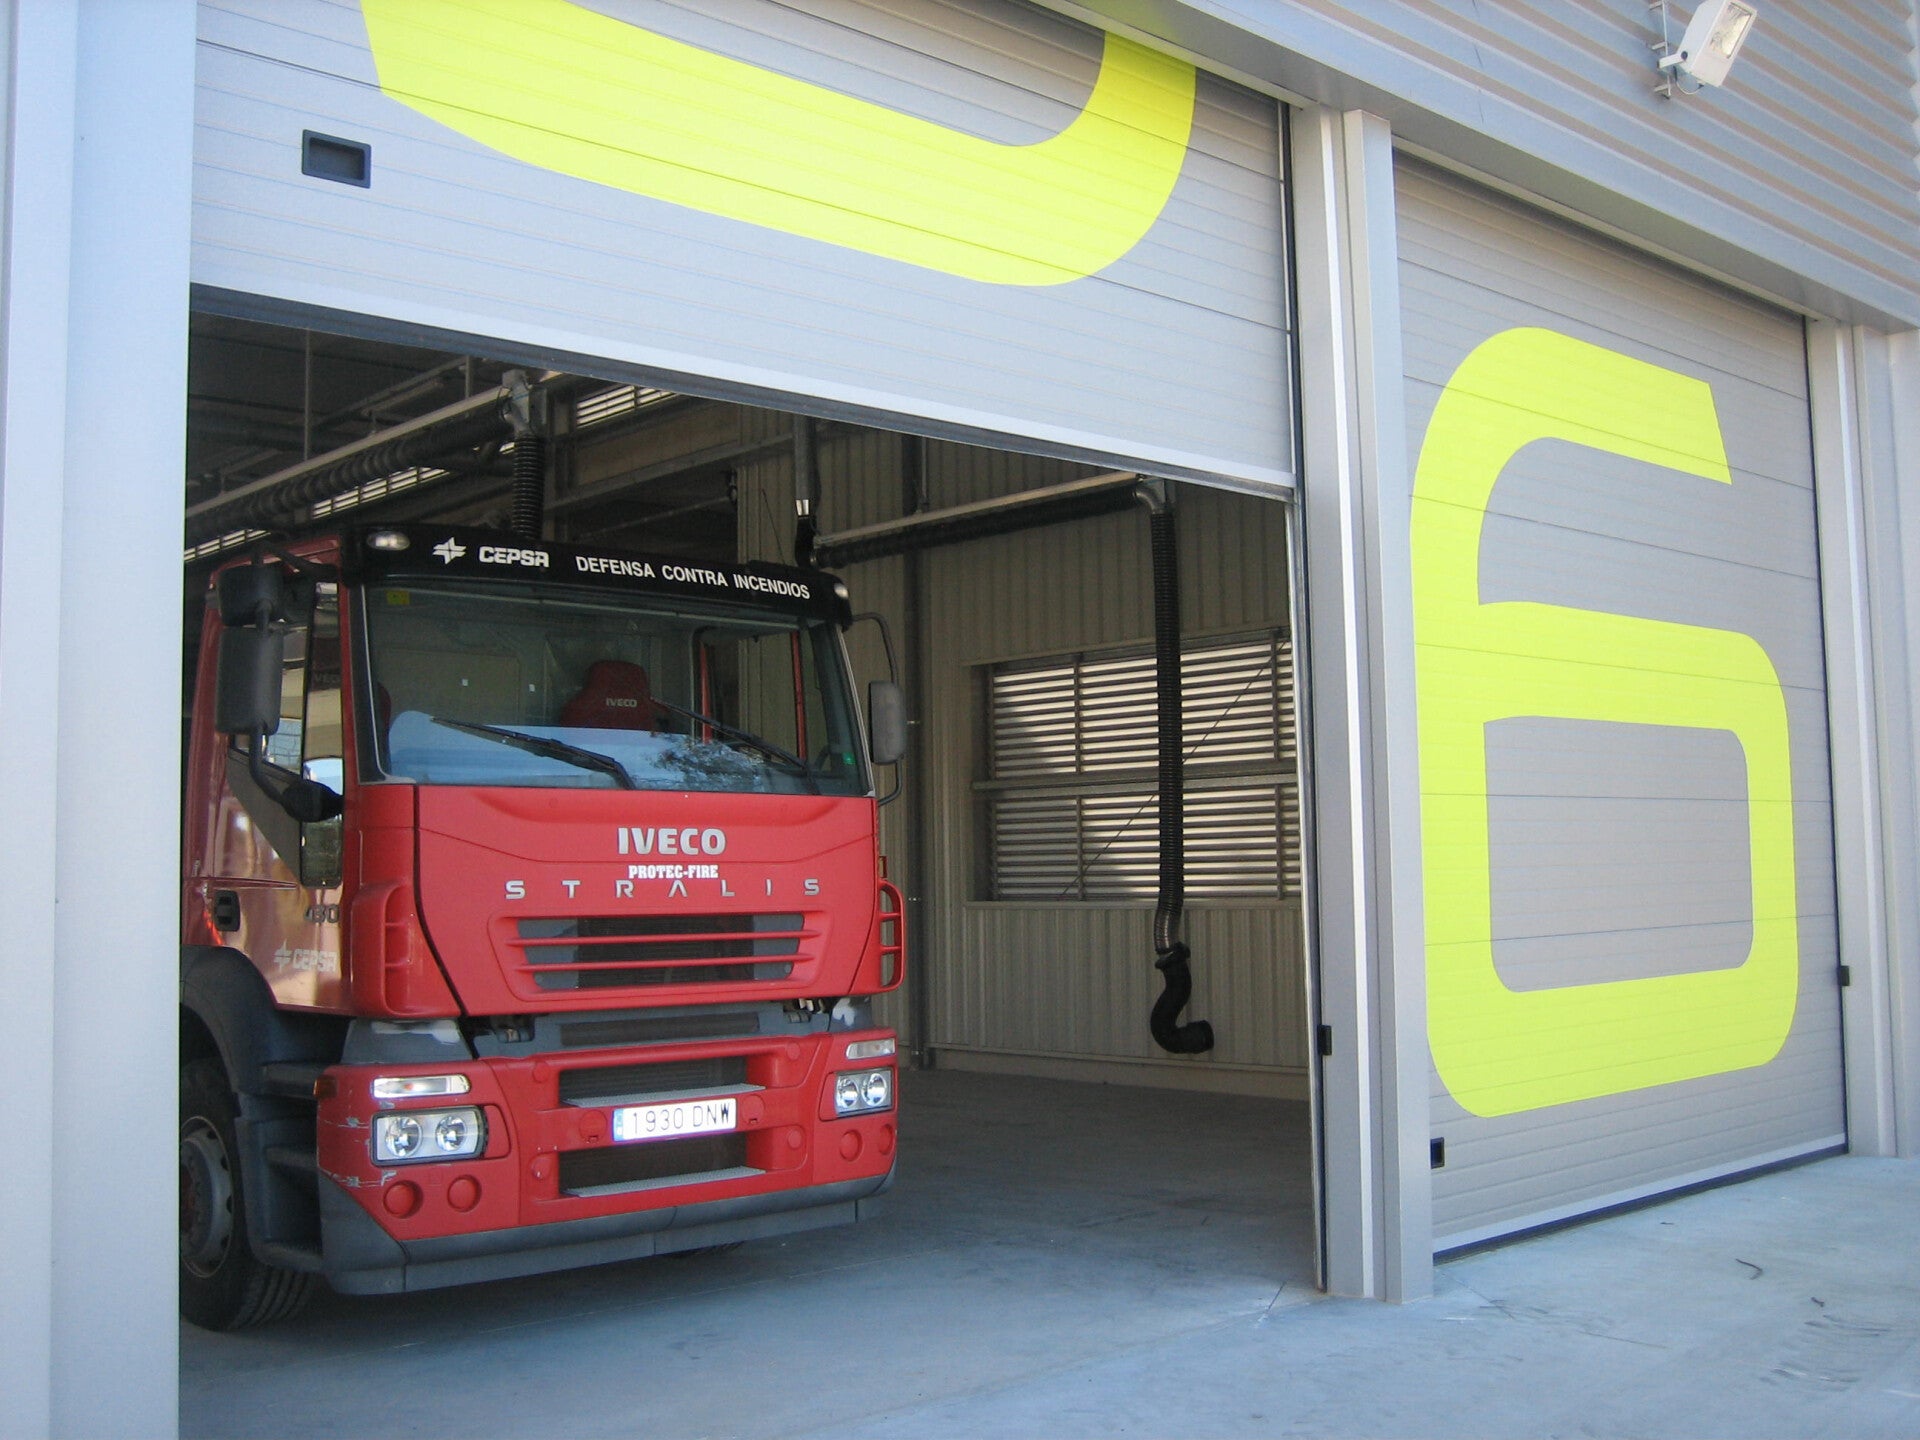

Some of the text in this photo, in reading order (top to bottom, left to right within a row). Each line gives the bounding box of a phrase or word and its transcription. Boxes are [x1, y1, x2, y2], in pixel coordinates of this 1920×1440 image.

[478, 545, 550, 568] CEPSA
[575, 555, 811, 600] DEFENSA CONTRA INCENDIOS
[605, 697, 638, 708] IVECO
[1410, 326, 1799, 1119] 6
[617, 826, 727, 856] IVECO
[628, 864, 719, 879] PROTEC-FIRE
[505, 878, 821, 901] STRALIS
[293, 948, 337, 972] CEPSA
[632, 1107, 684, 1135] 1930
[692, 1102, 730, 1128] DNW
